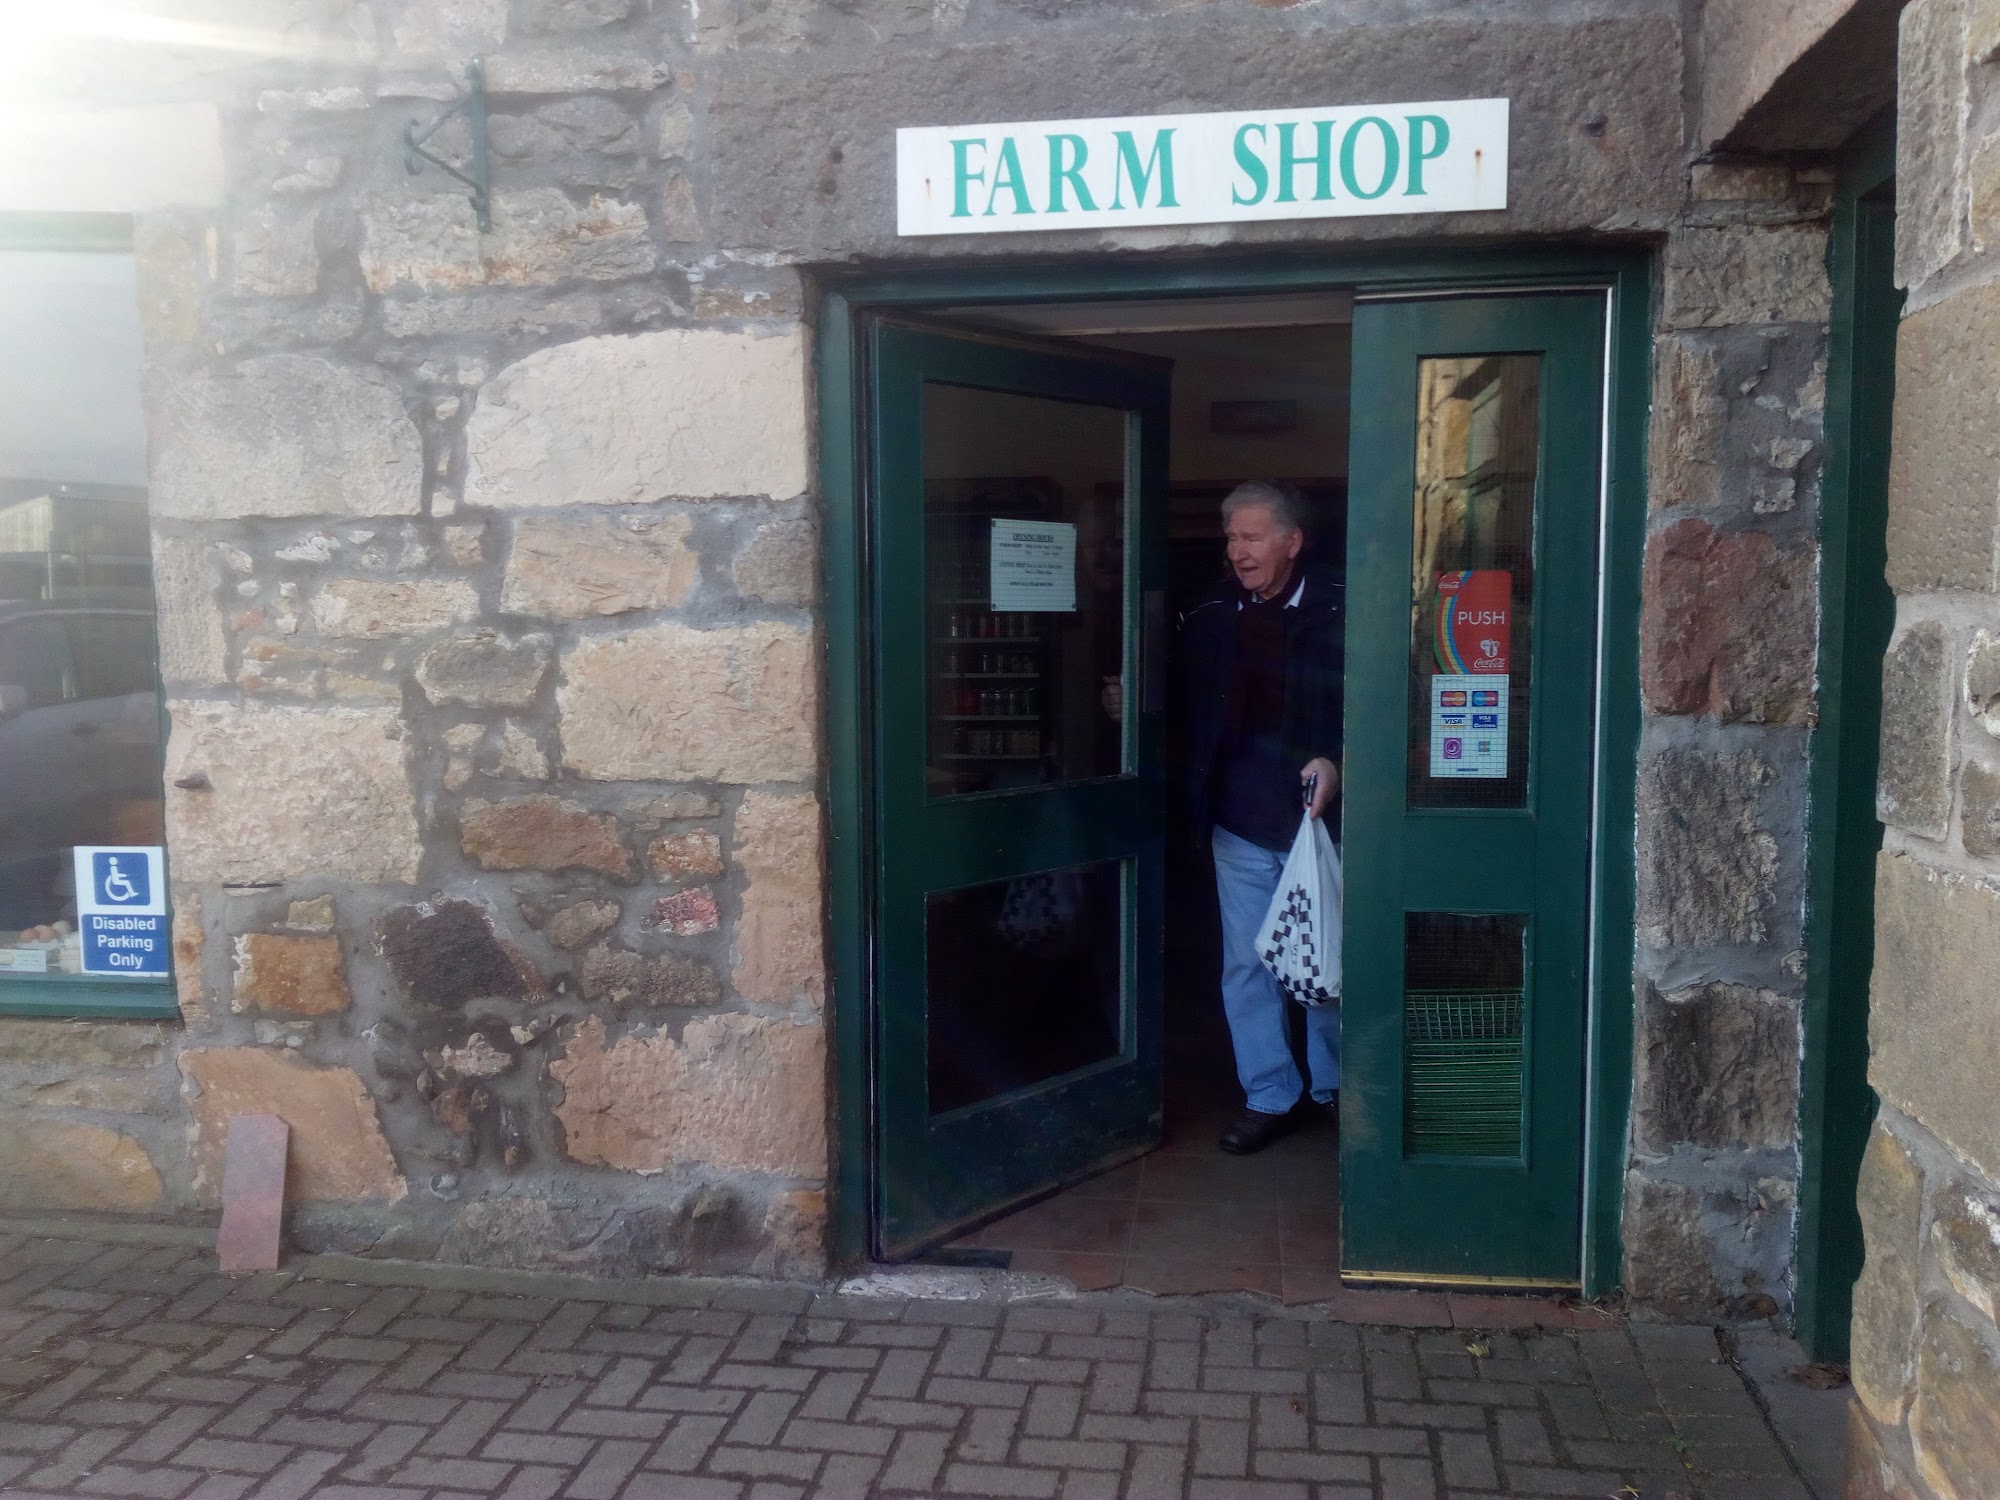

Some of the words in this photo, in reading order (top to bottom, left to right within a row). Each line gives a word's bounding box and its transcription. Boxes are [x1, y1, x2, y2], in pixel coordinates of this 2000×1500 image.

[948, 127, 1181, 218] FARM
[1231, 114, 1451, 207] SHOP
[1458, 611, 1505, 625] PUSH
[92, 916, 157, 931] Disabled
[97, 934, 154, 951] Parking
[108, 953, 144, 970] Only
